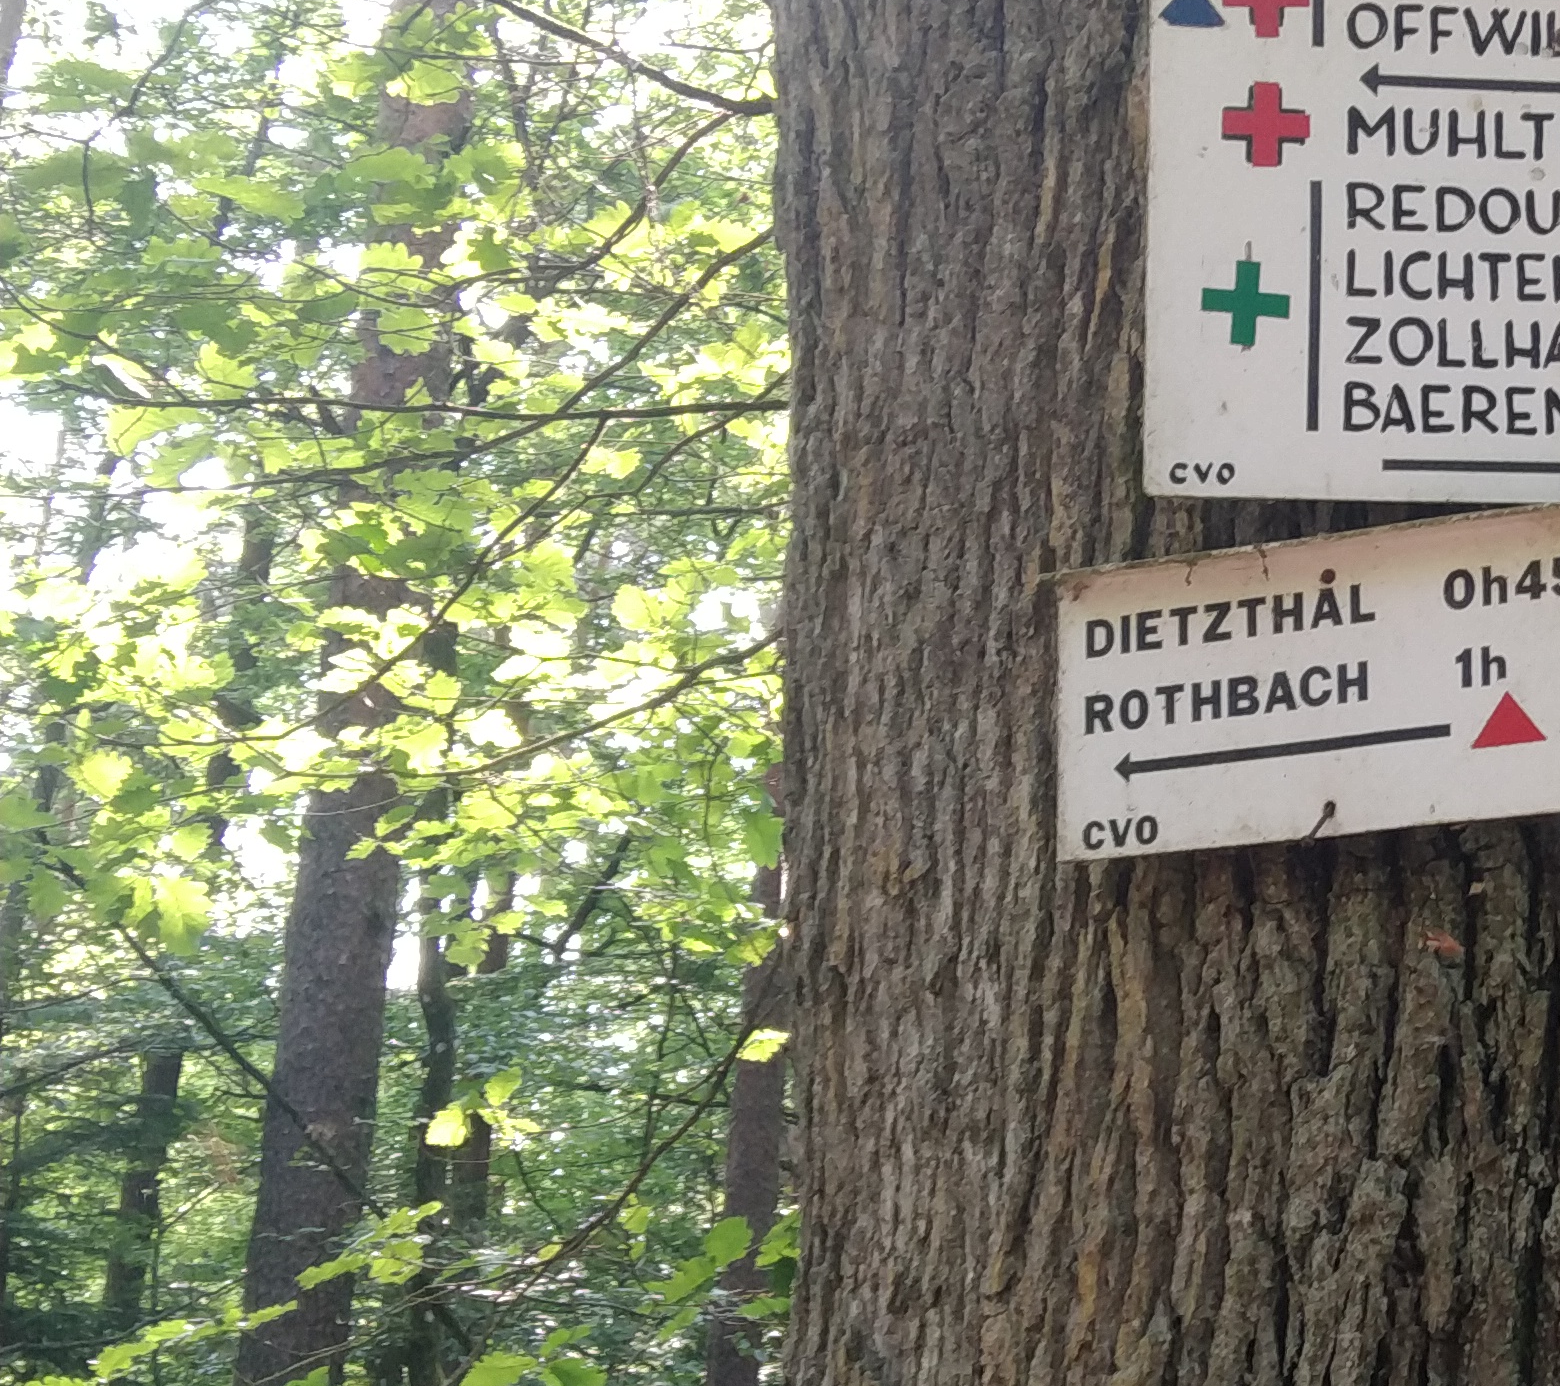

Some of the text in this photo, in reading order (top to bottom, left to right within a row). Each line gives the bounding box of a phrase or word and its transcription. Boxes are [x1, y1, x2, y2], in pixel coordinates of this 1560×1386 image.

[1085, 583, 1377, 660] DIETZTHAL
[1084, 645, 1508, 736] ROTHBACH 1h
